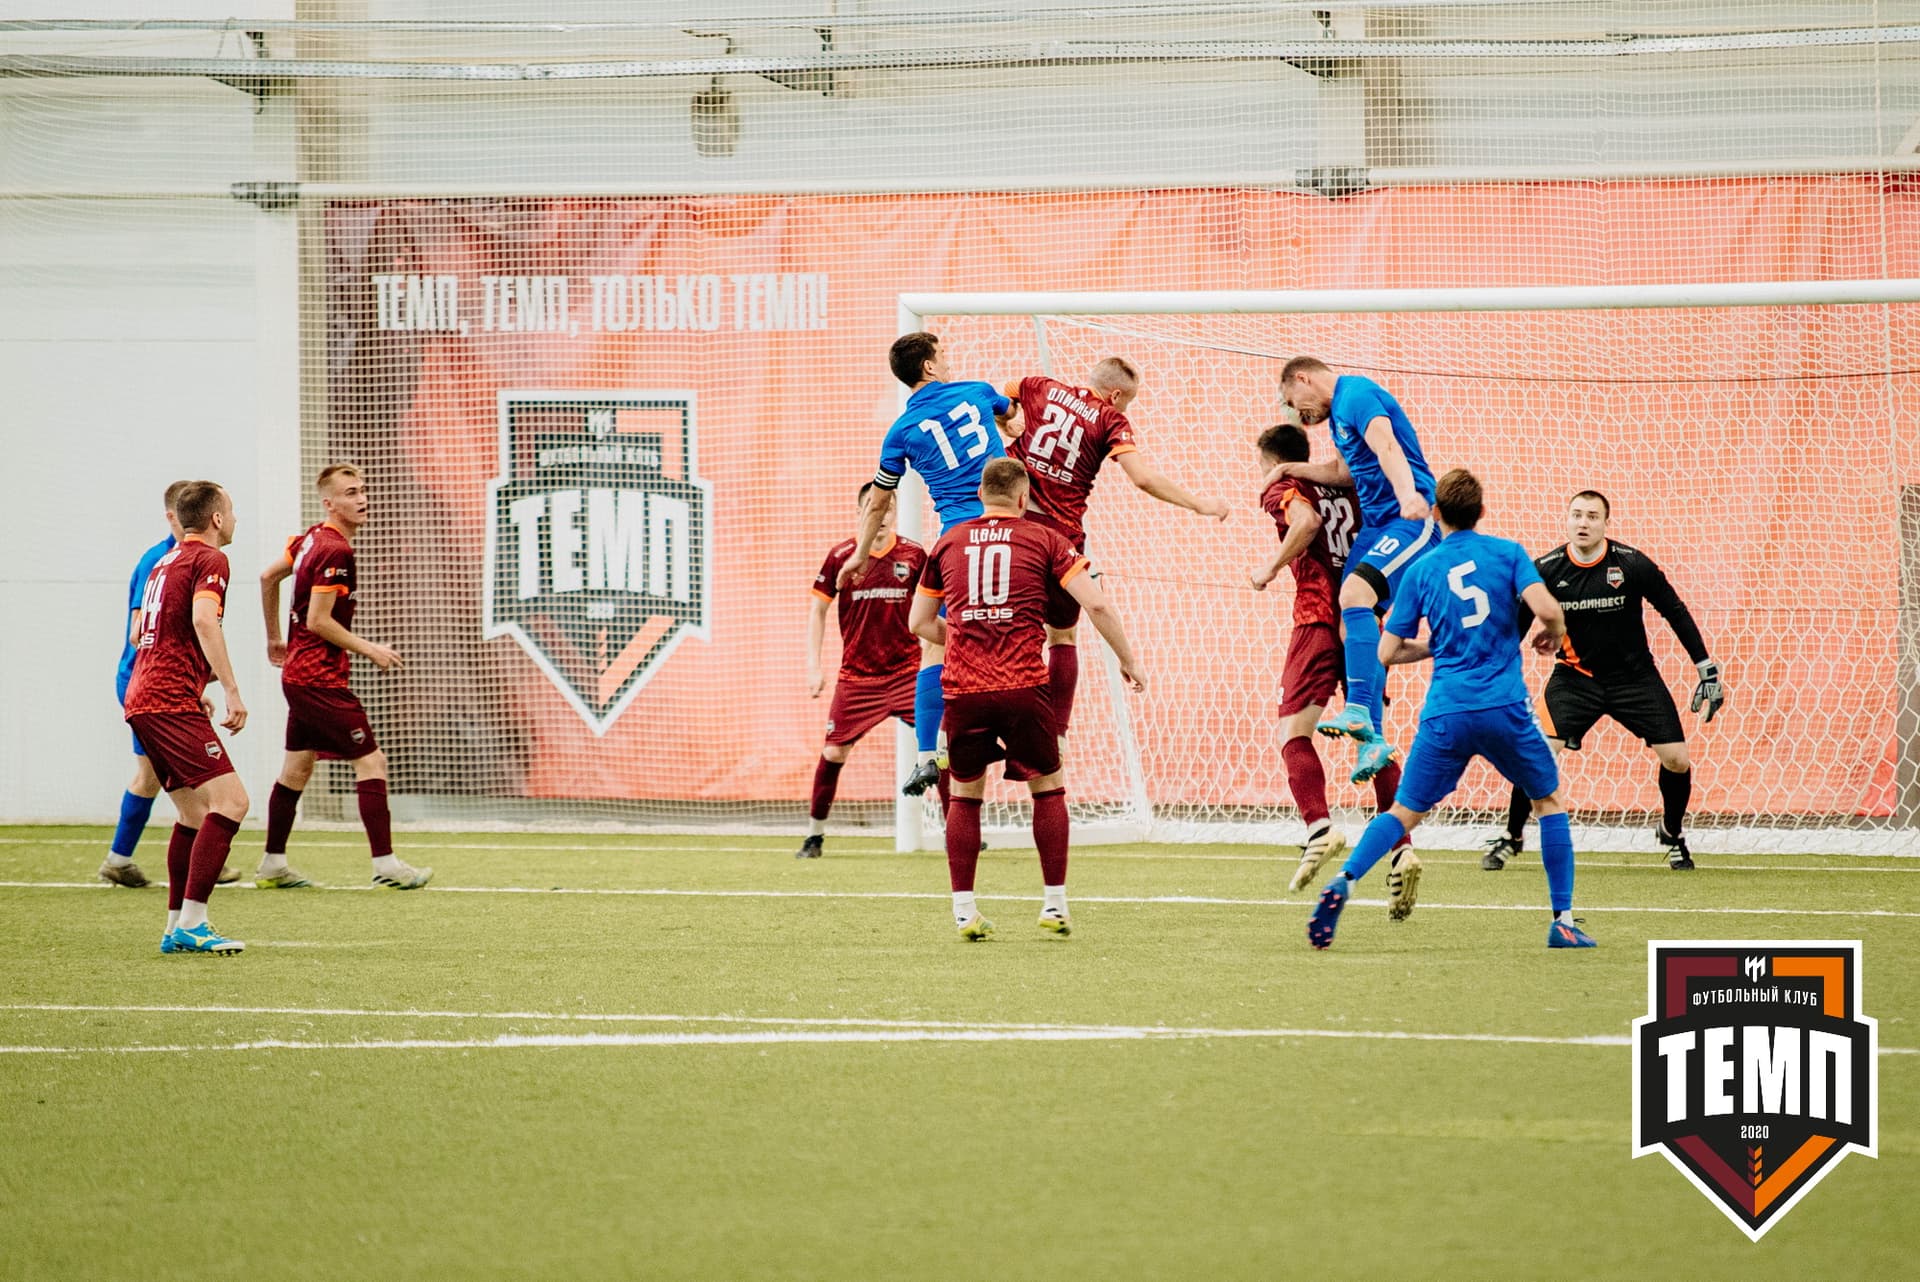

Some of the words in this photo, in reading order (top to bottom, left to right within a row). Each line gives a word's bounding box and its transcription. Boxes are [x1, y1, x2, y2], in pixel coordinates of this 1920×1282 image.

[371, 274, 469, 337] ТЕМП,
[480, 275, 579, 337] ТЕМП,
[589, 273, 721, 331] ТОЛЬКО
[730, 272, 829, 331] ТЕМП!
[918, 401, 989, 471] 13
[1028, 403, 1085, 470] 24
[510, 488, 690, 604] ТЕМП
[969, 527, 1013, 545] ЦВЫК
[1318, 497, 1354, 557] 22
[1374, 535, 1400, 555] 10
[964, 544, 1012, 606] 10
[1446, 559, 1491, 629] 5
[1560, 596, 1626, 611] ПРОДИНВЕСТ
